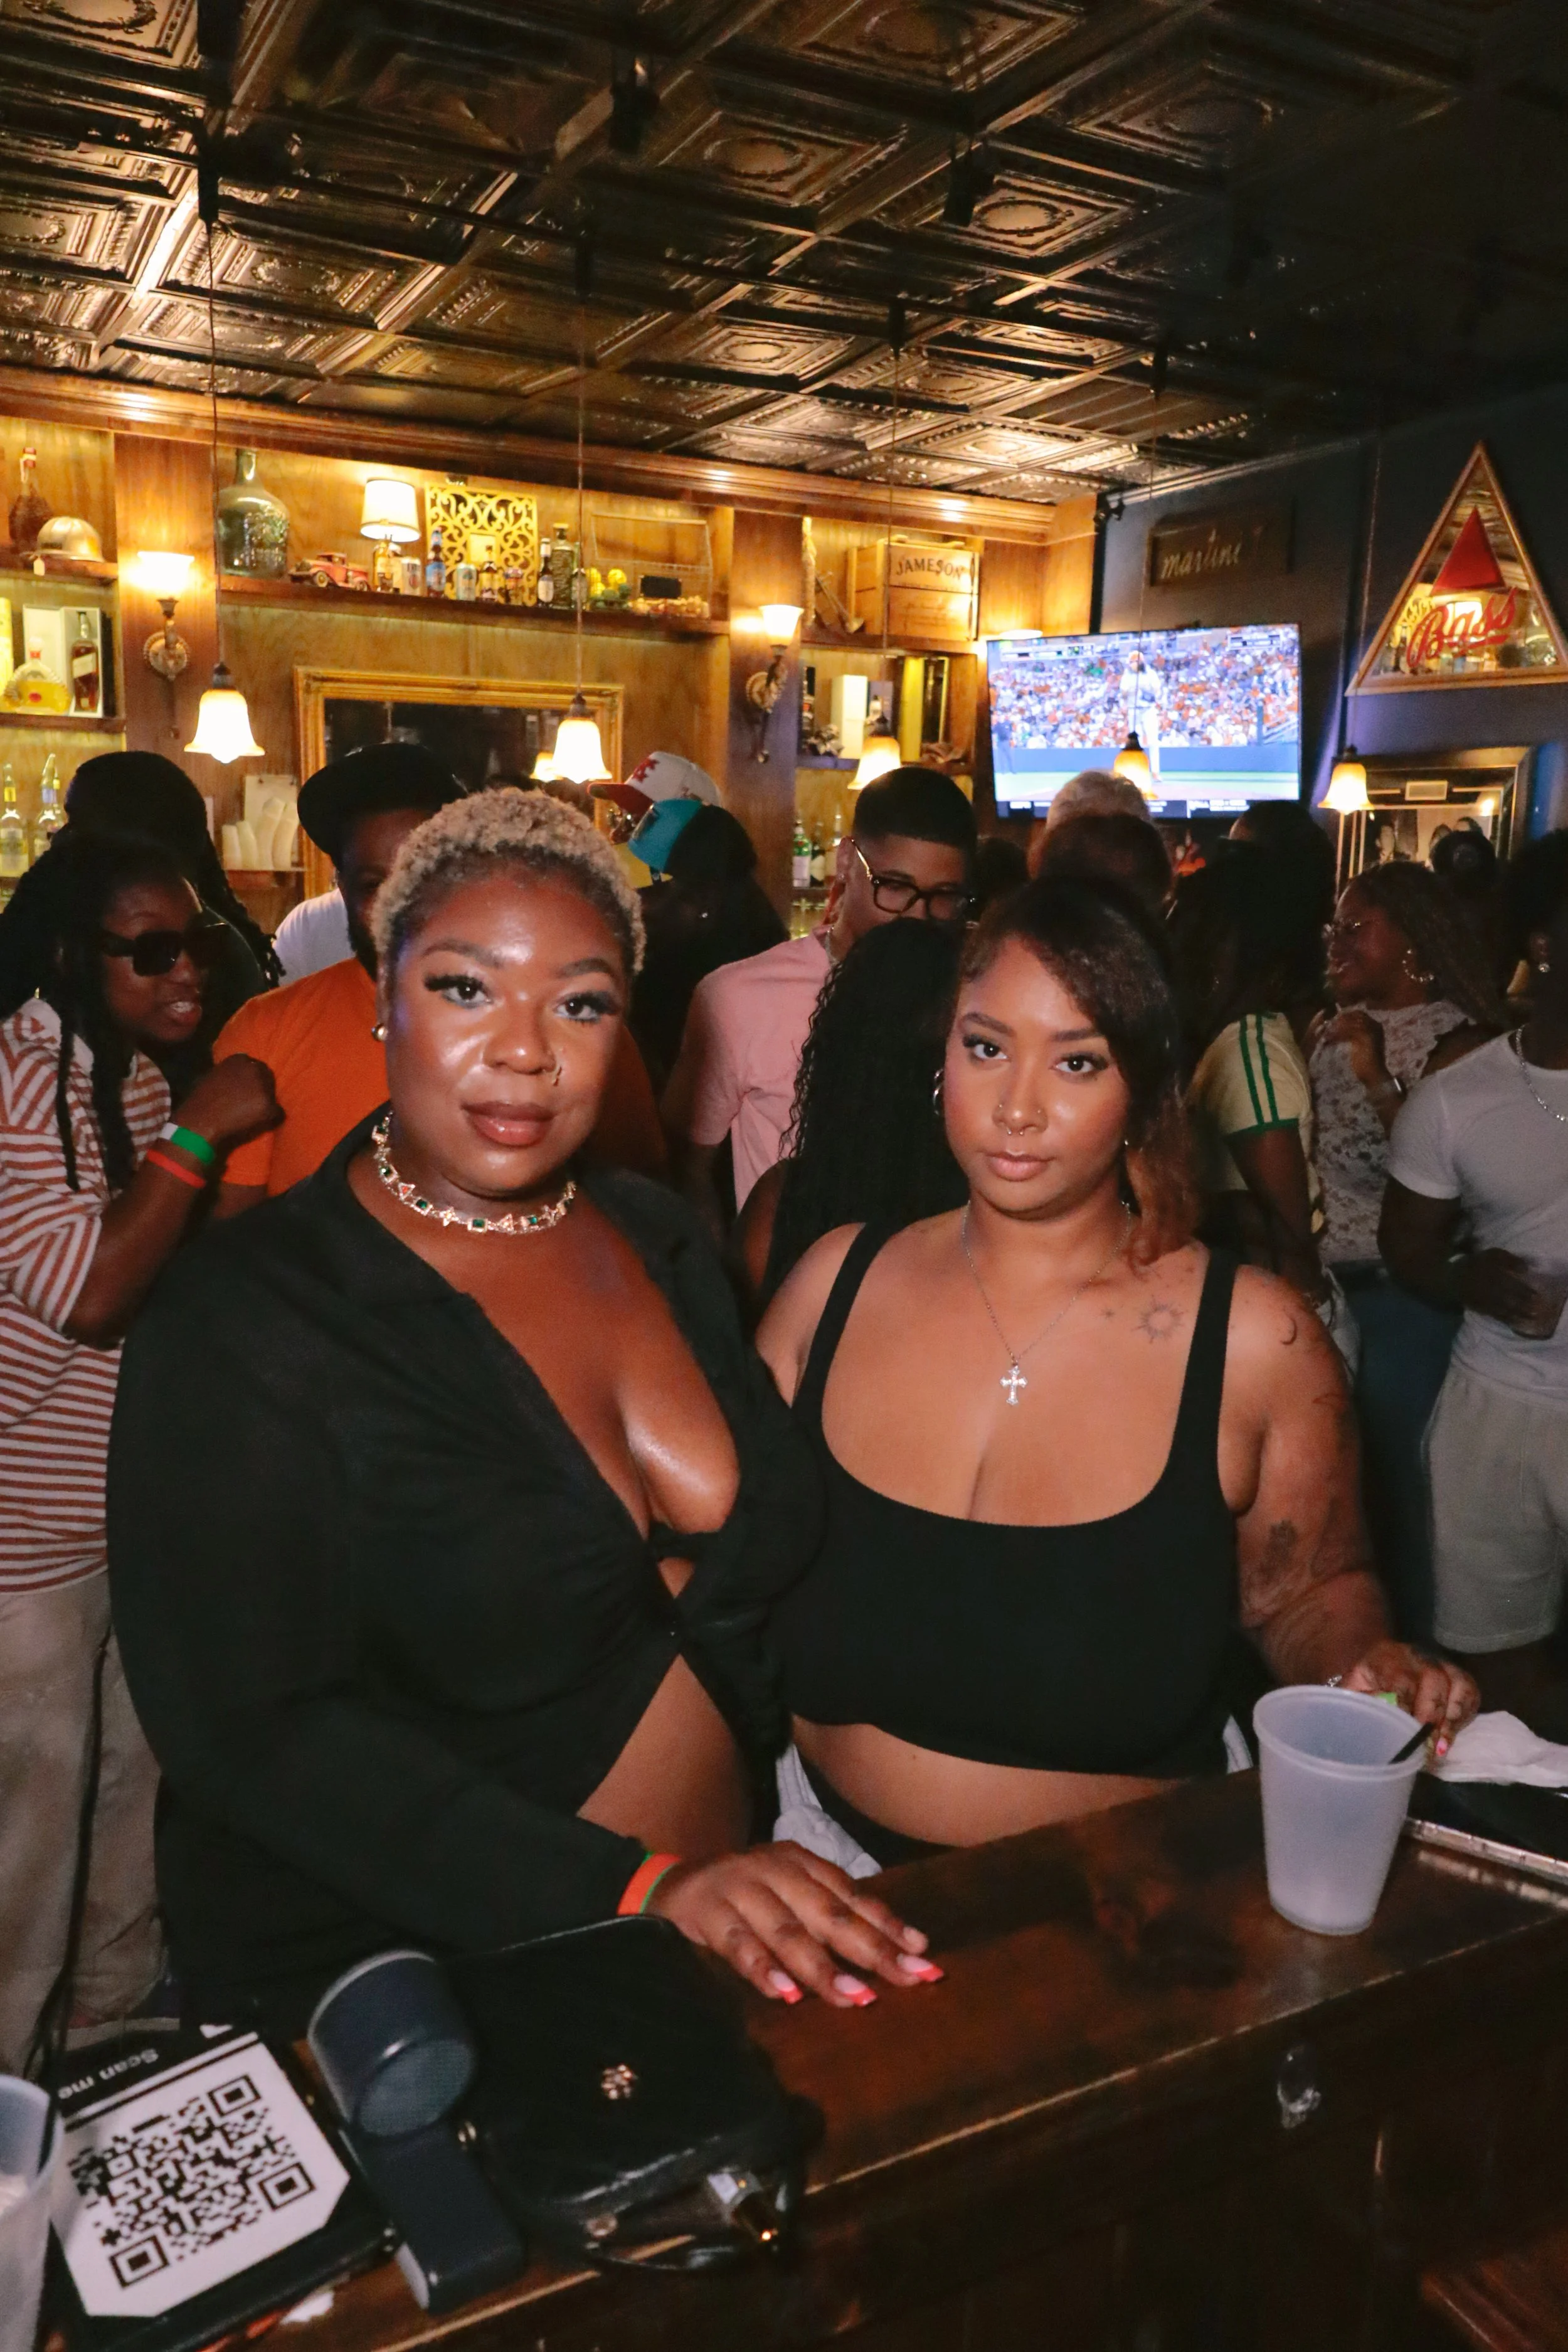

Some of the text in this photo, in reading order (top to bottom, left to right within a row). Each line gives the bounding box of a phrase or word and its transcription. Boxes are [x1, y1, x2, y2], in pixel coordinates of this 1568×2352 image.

[896, 557, 965, 580] JAMESON
[1406, 586, 1517, 669] Bass
[57, 2048, 159, 2100] Scan me
